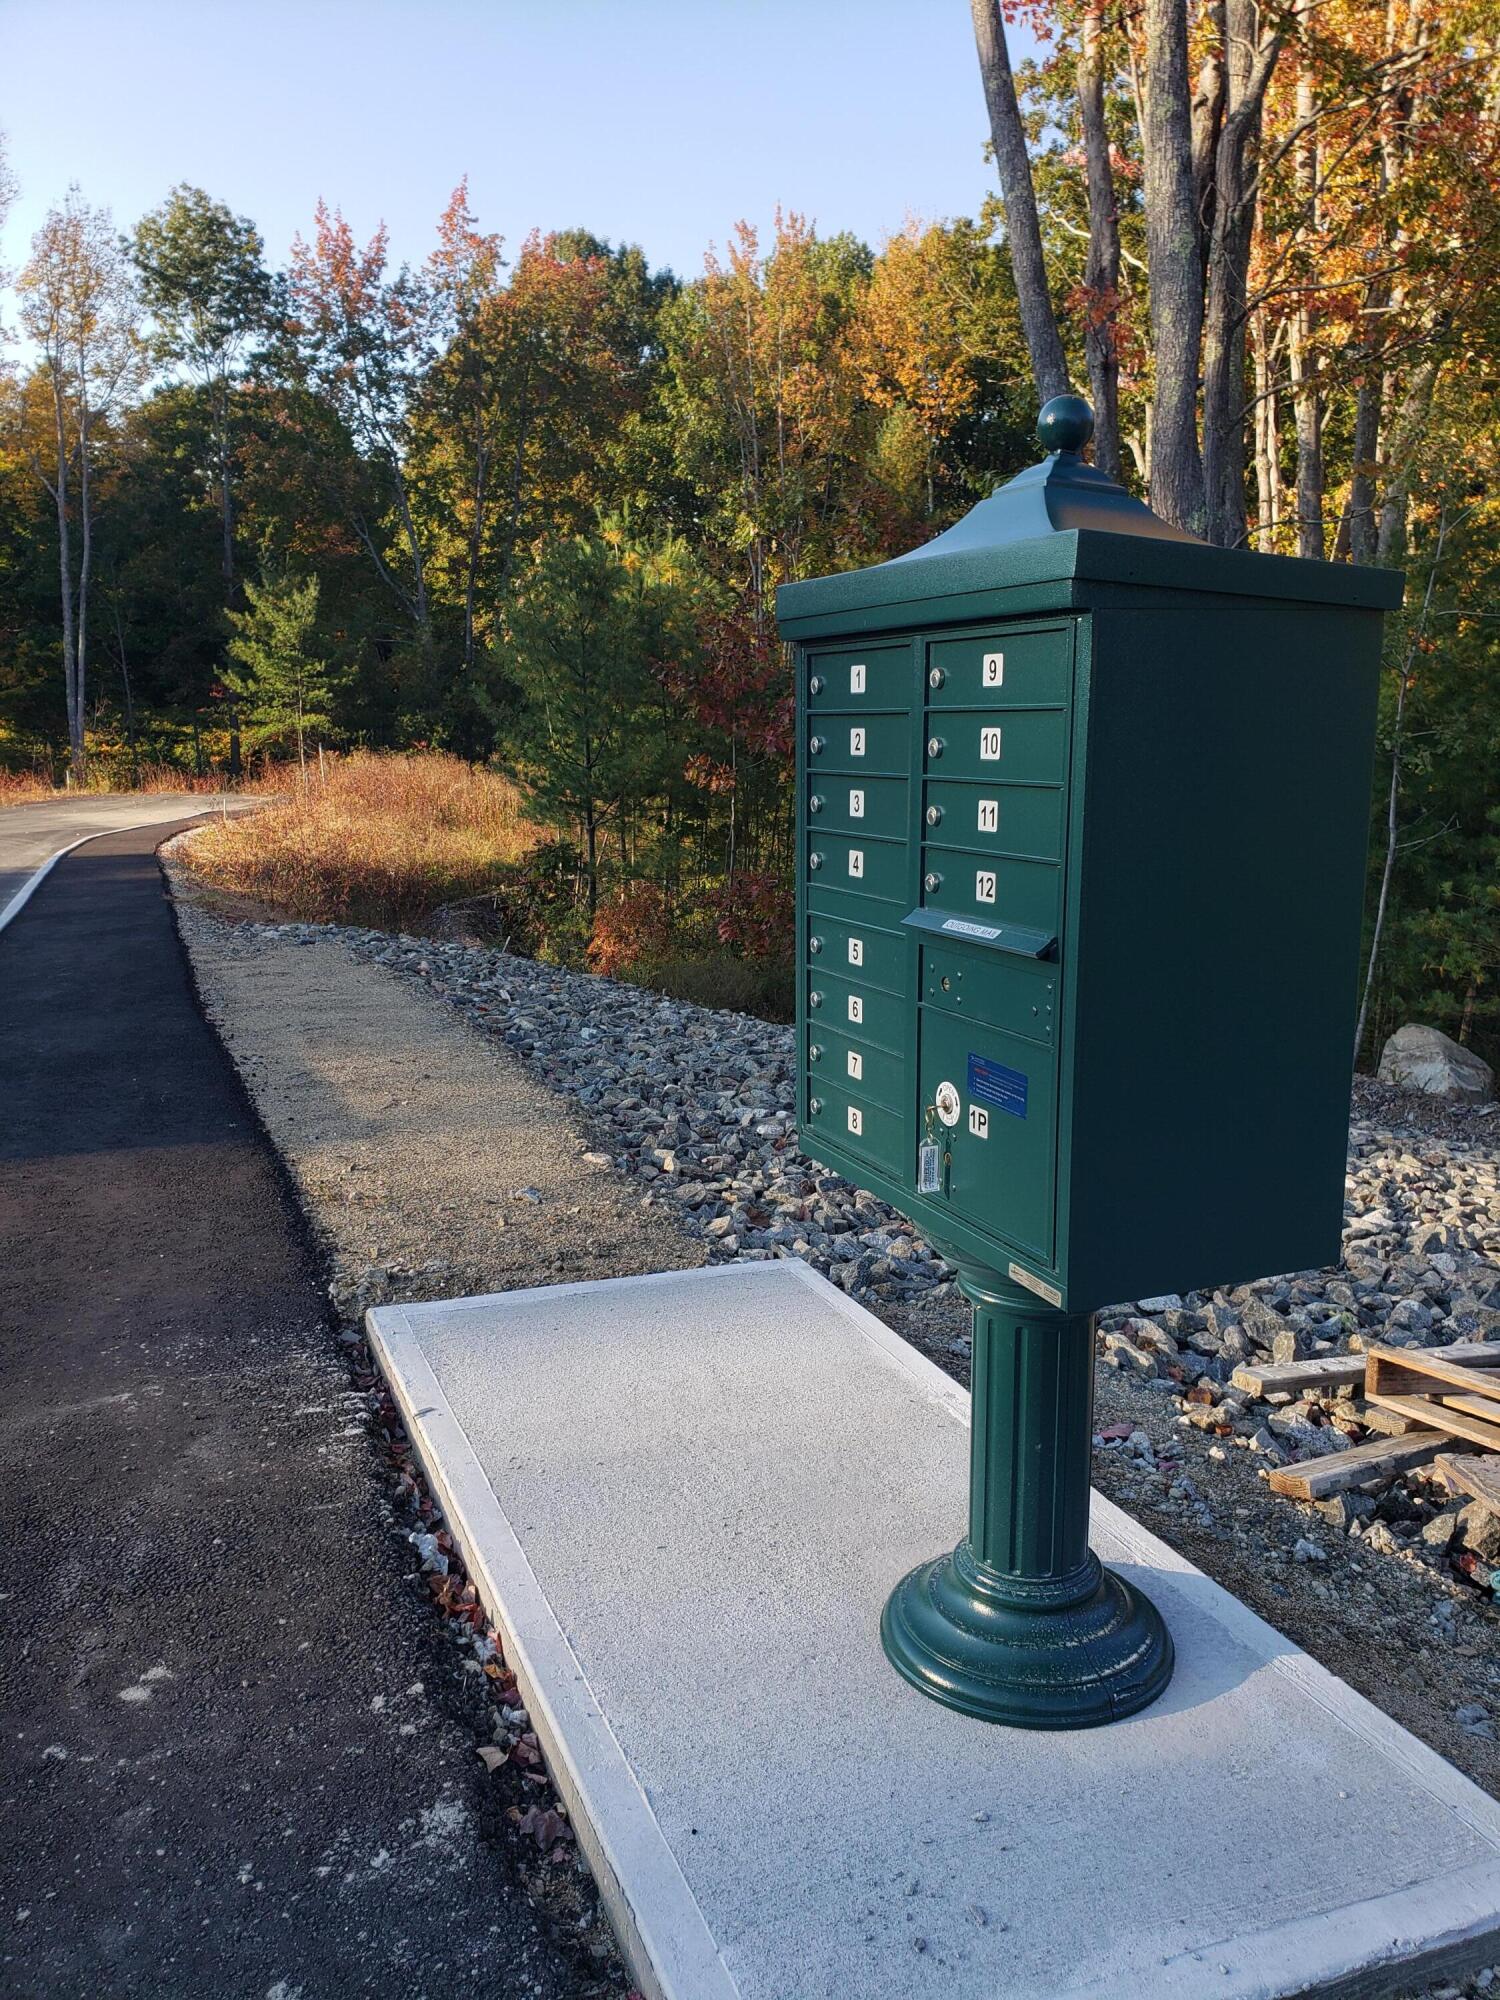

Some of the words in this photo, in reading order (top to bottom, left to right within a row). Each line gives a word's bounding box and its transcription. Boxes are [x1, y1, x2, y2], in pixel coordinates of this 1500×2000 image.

[855, 669, 861, 688] 1
[989, 659, 997, 682] 9
[854, 732, 861, 751] 2
[983, 733, 999, 755] 10
[854, 794, 860, 813] 3
[981, 805, 995, 827] 11
[853, 855, 859, 873] 4
[978, 876, 994, 898] 12
[946, 921, 981, 934] OUTGOING
[981, 928, 998, 938] MAIL
[852, 943, 859, 961] 5
[852, 1000, 858, 1018] 6
[852, 1056, 858, 1073] 7
[852, 1112, 858, 1129] 8
[970, 1110, 987, 1132] 1P
